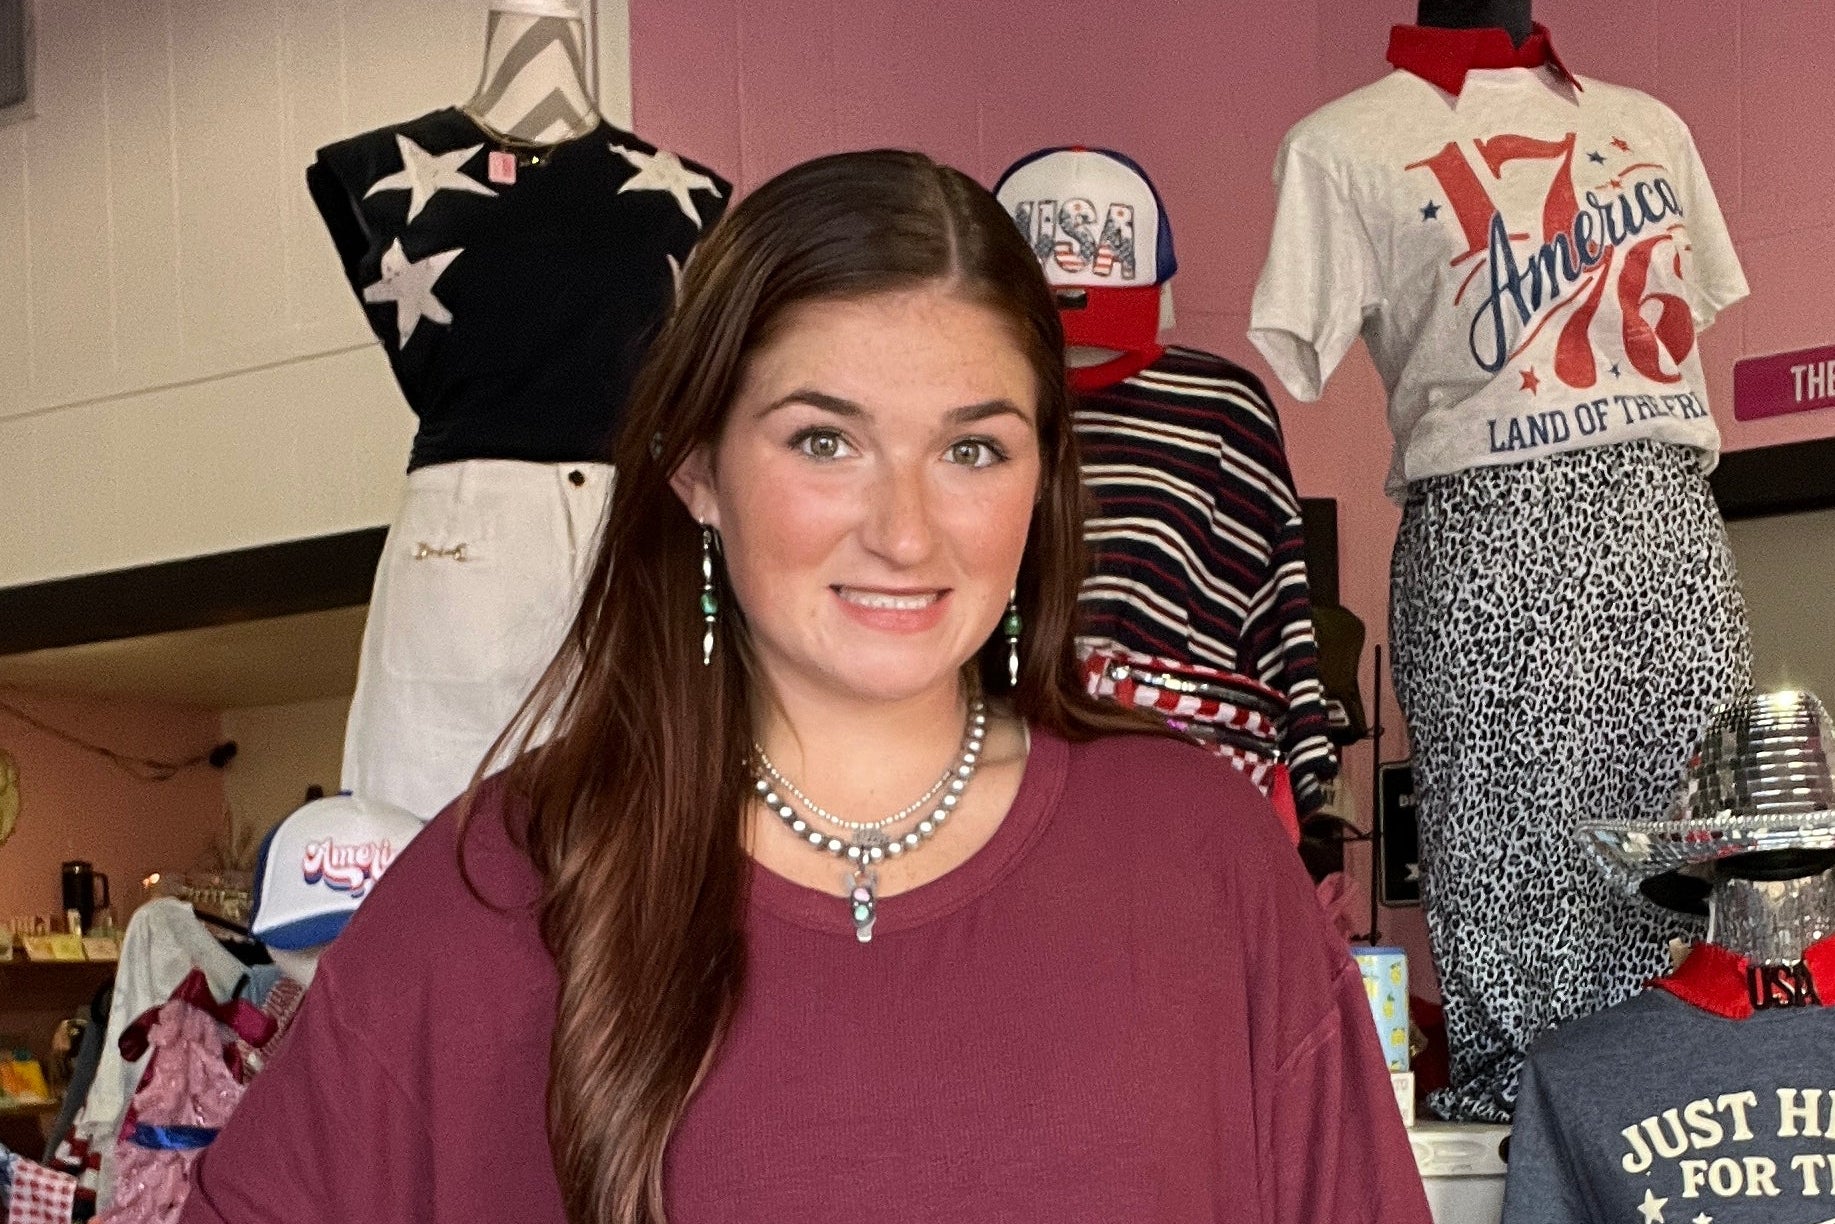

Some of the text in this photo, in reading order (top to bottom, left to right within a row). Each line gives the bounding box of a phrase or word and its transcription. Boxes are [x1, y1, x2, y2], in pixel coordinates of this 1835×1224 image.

[1013, 198, 1136, 280] USA
[1405, 132, 1580, 267] 17
[1469, 180, 1684, 374] America
[1488, 410, 1572, 452] LAND
[1574, 399, 1610, 436] OF
[1747, 961, 1823, 1009] USA
[1621, 1090, 1758, 1174] JUST
[1679, 1153, 1835, 1198] FOR T
